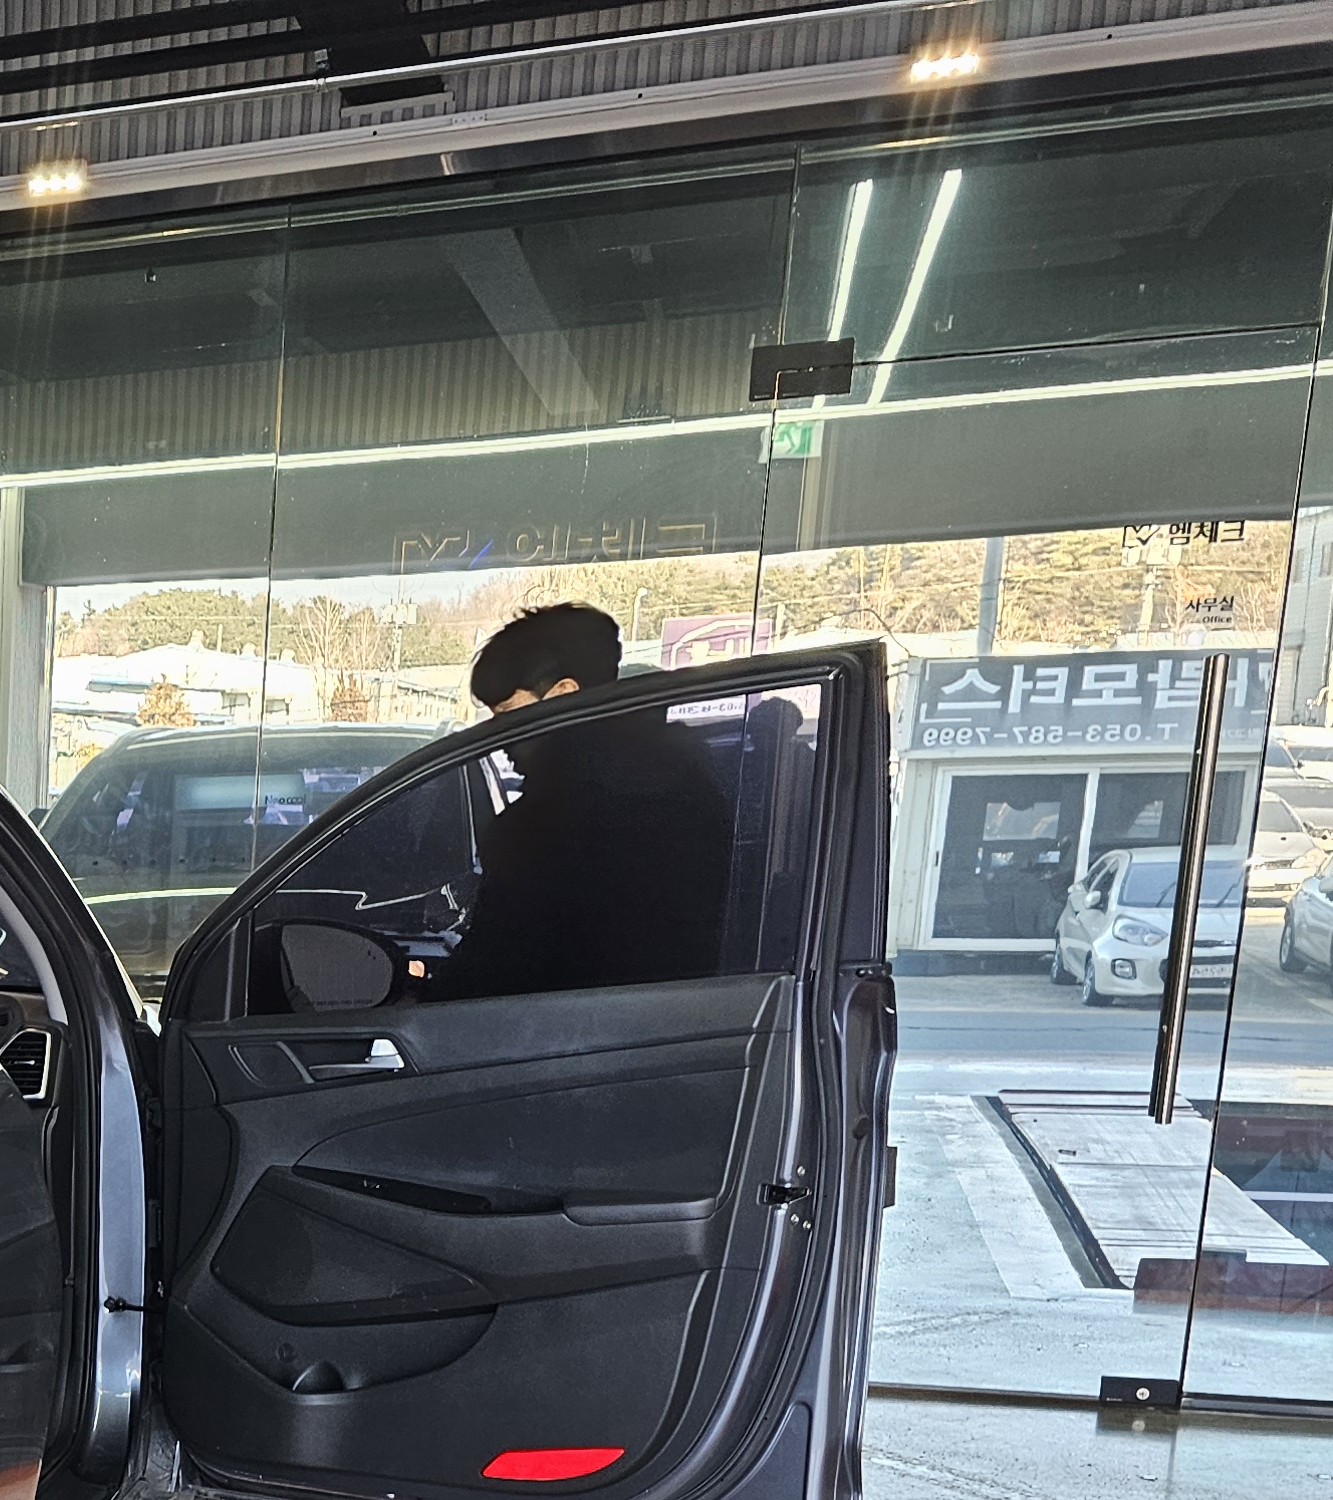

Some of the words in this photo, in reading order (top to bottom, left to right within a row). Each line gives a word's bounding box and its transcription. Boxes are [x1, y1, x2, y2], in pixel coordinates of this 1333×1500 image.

[1169, 519, 1245, 546] 엠체크
[1184, 595, 1234, 613] 사무실
[1201, 615, 1233, 624] Office
